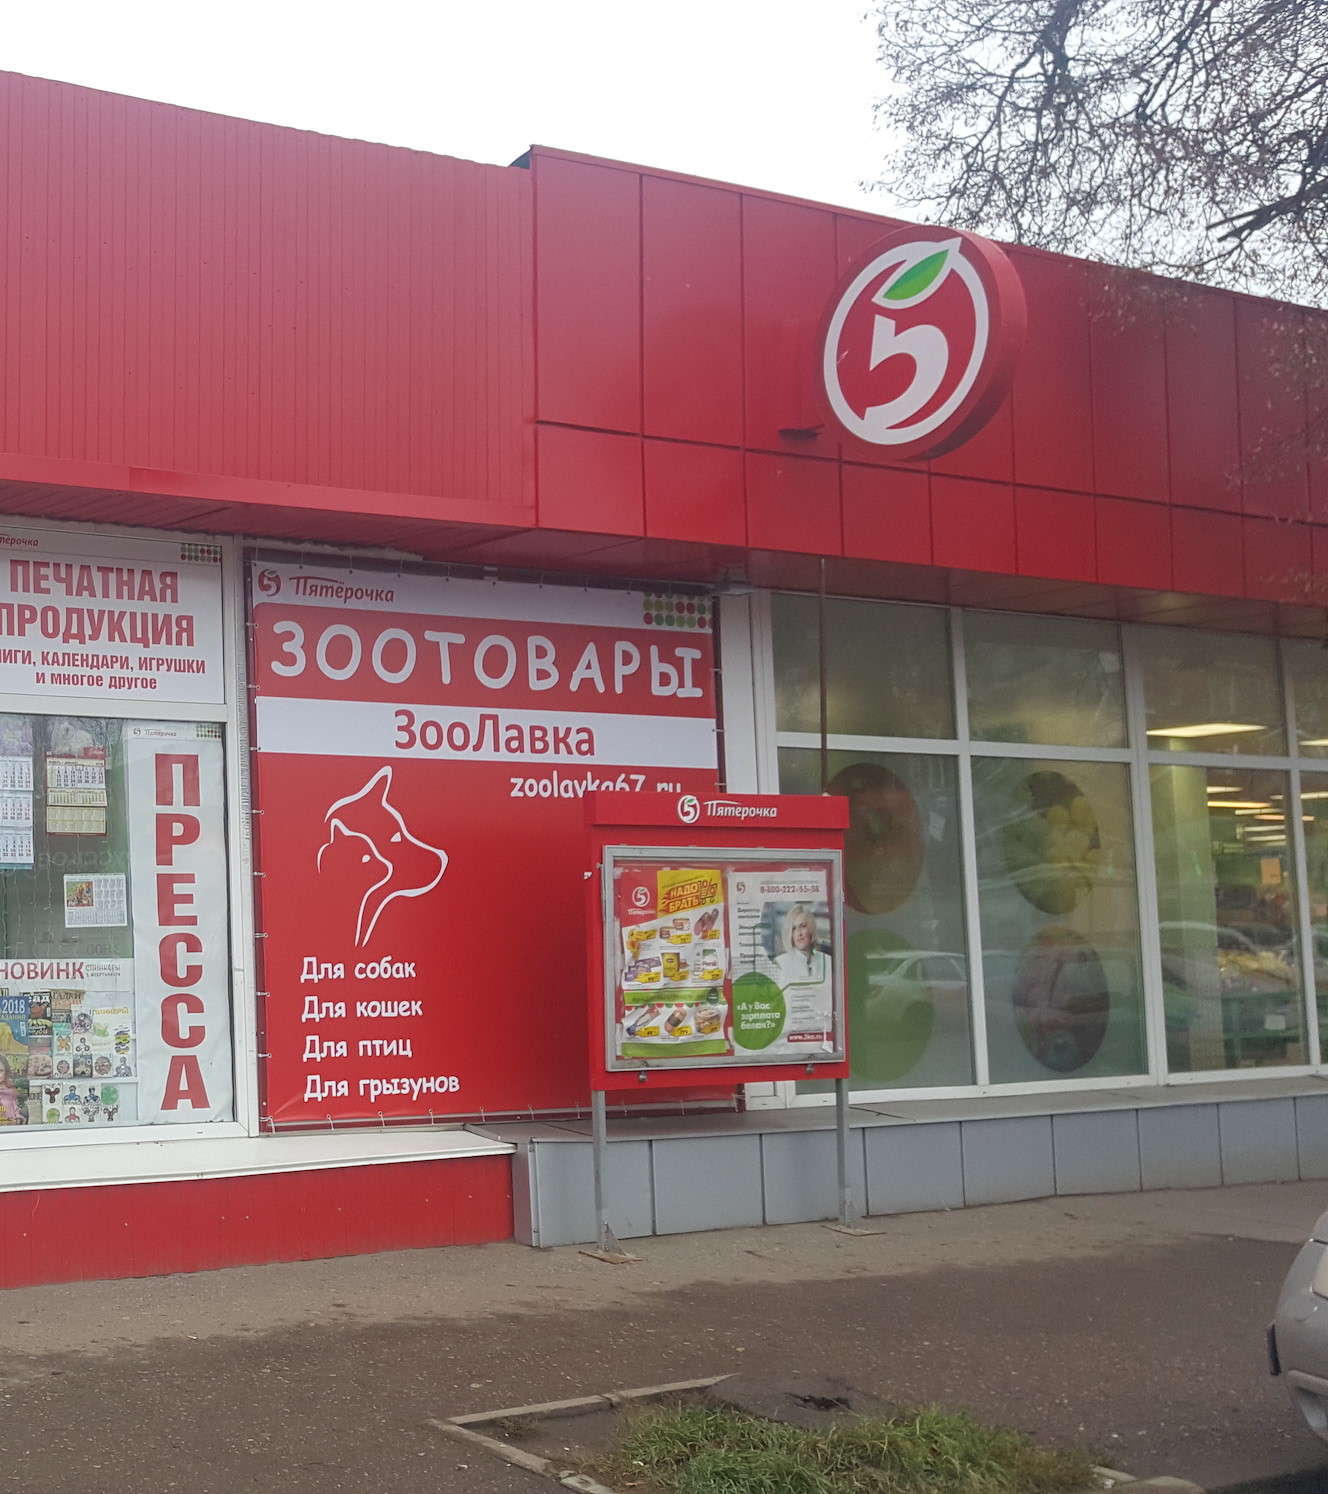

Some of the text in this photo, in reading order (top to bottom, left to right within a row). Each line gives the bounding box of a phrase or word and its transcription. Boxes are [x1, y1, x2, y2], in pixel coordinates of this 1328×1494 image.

[9, 559, 179, 603] ПЕЧАТНАЯ
[41, 651, 134, 672] КАЛЕНДАРИ,
[138, 656, 206, 674] ИГРУШКИ
[272, 620, 703, 698] ЗООТОВАРЫ
[36, 672, 157, 690] и многое другое
[394, 709, 595, 756] ЗооЛавка
[670, 883, 698, 898] НАДО
[669, 896, 699, 913] БРАТЬ
[155, 753, 211, 1111] ПРЕССА
[300, 955, 416, 983] Для собак
[2, 999, 25, 1014] 2018
[301, 996, 423, 1022] Для кошек
[741, 1012, 781, 1021] зарплата
[754, 1002, 771, 1010] Вас
[302, 1035, 413, 1062] Для птиц
[304, 1074, 460, 1103] Для грызунов
